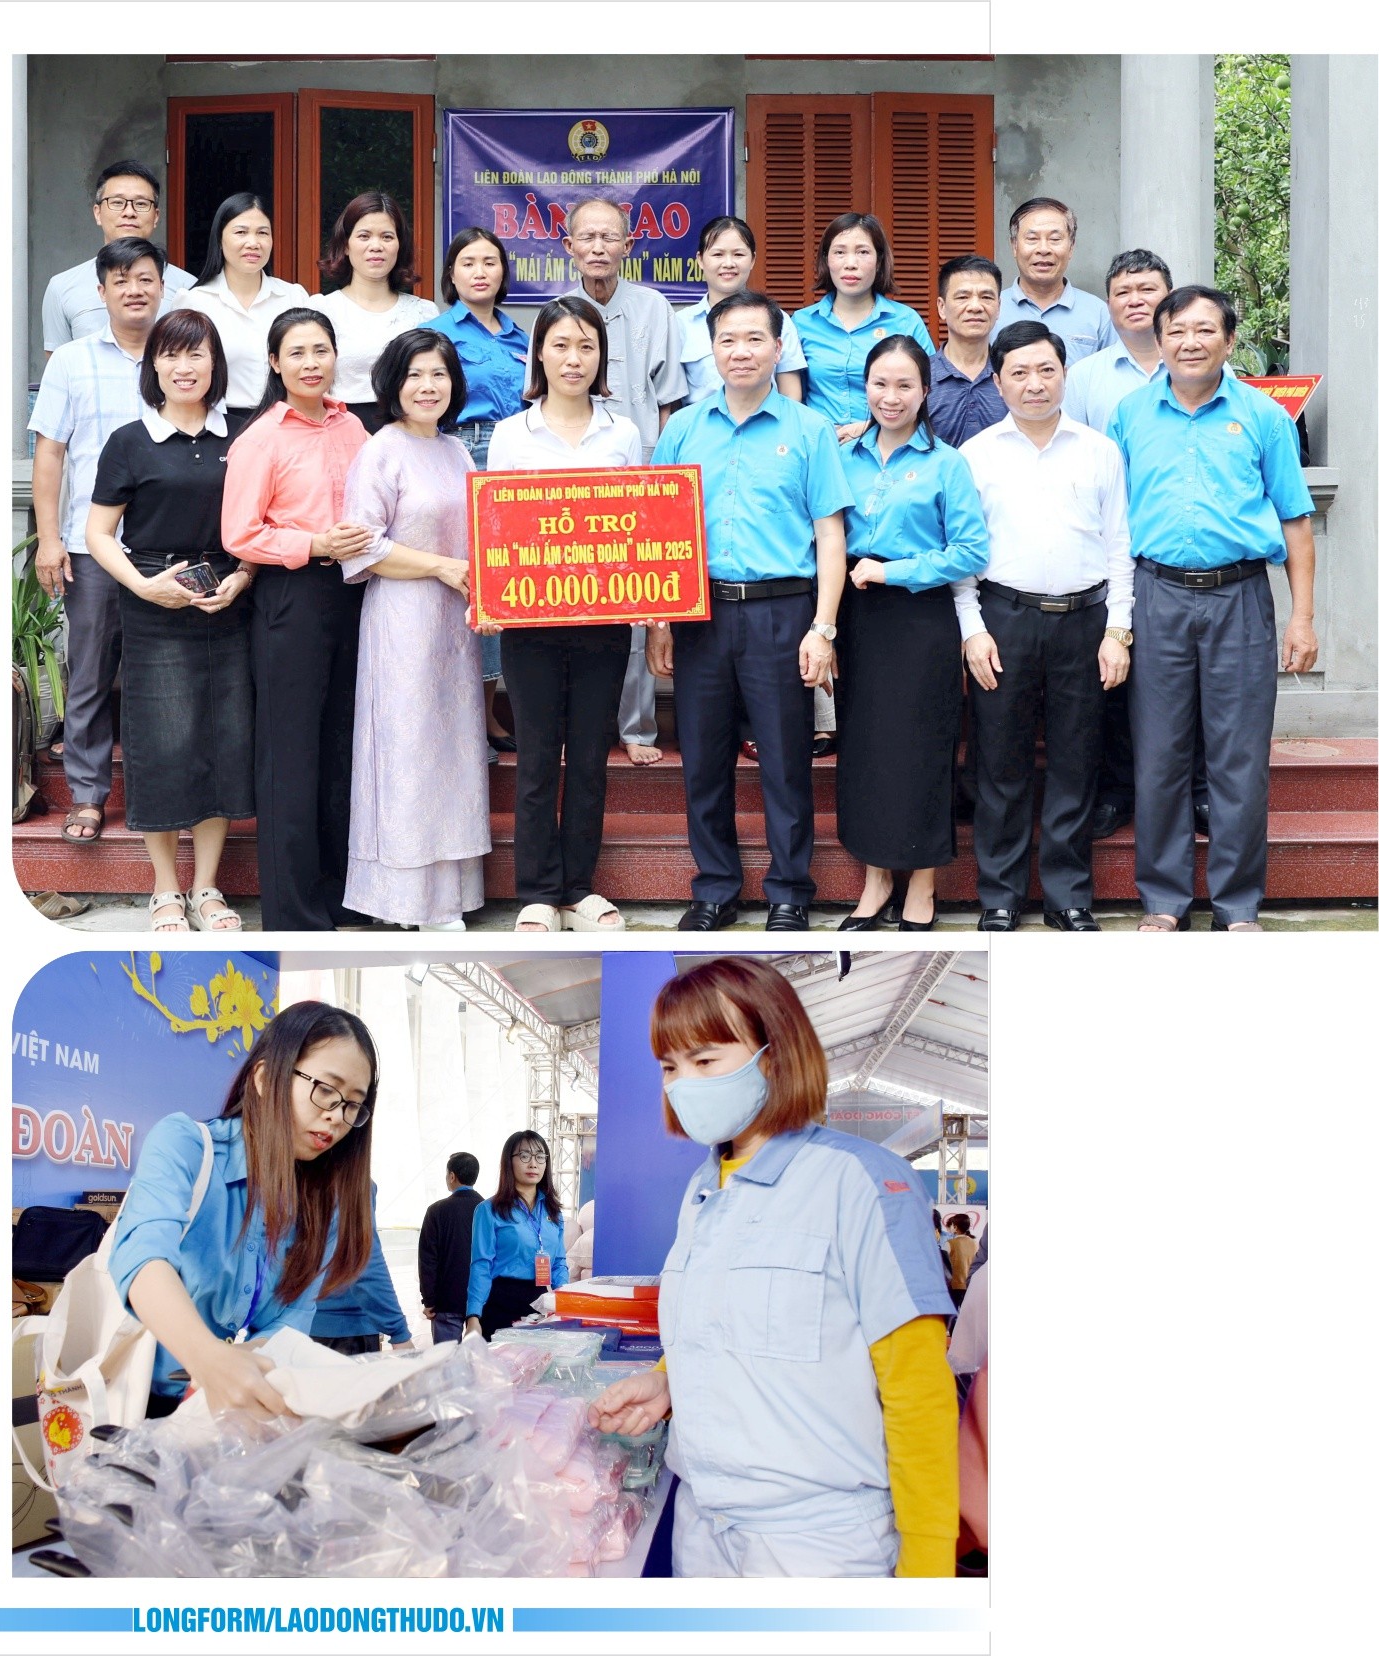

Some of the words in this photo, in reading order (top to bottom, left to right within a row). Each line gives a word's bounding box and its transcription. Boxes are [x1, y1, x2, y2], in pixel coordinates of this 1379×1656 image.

[475, 169, 499, 185] LIÊN
[502, 168, 533, 185] ĐOÀN
[537, 172, 558, 184] LAO
[561, 168, 592, 186] ĐỘNG
[596, 168, 633, 184] THÀNH
[636, 166, 659, 184] PHỐ
[662, 168, 678, 184] HÀ
[681, 169, 701, 187] NỘI
[544, 249, 564, 282] ẤM
[653, 252, 683, 282] NĂM
[493, 485, 514, 503] LIÊN
[517, 484, 542, 501] ĐOÀN
[545, 487, 562, 500] LAO
[565, 484, 590, 502] ĐỘNG
[593, 482, 624, 498] THÀNH
[626, 480, 645, 497] PHỐ
[647, 481, 660, 496] HÀ
[662, 480, 679, 499] NỘI
[538, 507, 575, 535] HỖ
[584, 511, 637, 536] TRỢ
[486, 545, 510, 567] NHÀ
[543, 539, 561, 565] ẤM
[564, 540, 594, 565] CÔNG
[636, 540, 662, 561] NĂM
[665, 540, 693, 560] 2025
[500, 571, 681, 608] 40.000.000đ
[56, 1044, 100, 1075] NAM
[12, 1103, 134, 1172] ĐOÀN
[88, 1193, 117, 1204] goldsun
